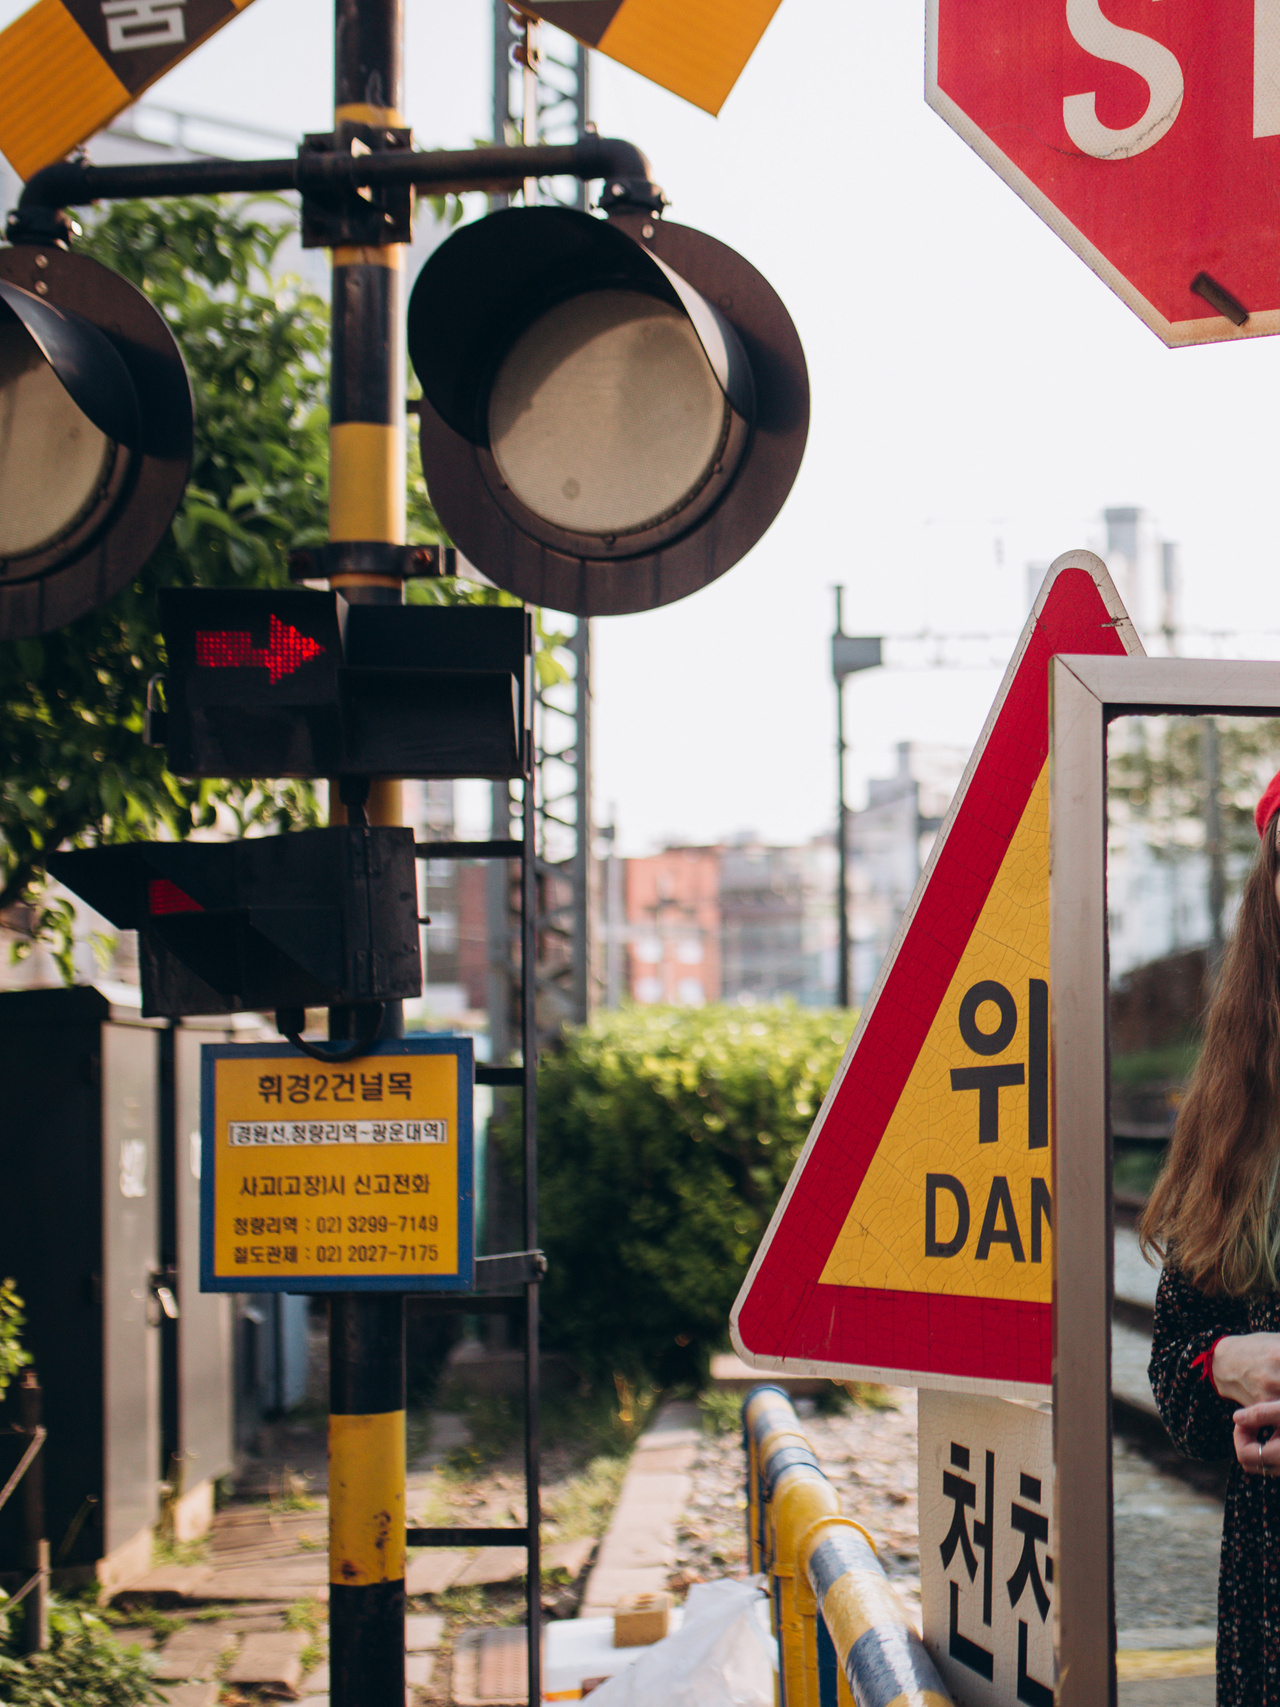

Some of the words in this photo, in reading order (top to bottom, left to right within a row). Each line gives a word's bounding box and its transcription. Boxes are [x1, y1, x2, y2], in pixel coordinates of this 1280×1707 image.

[950, 978, 1048, 1150] 위
[258, 1071, 412, 1104] 휘경2건널목
[354, 1174, 430, 1195] 신고전화
[233, 1216, 298, 1236] 청량리역
[347, 1215, 438, 1233] 3299-7149
[347, 1244, 438, 1262] 2027-7175
